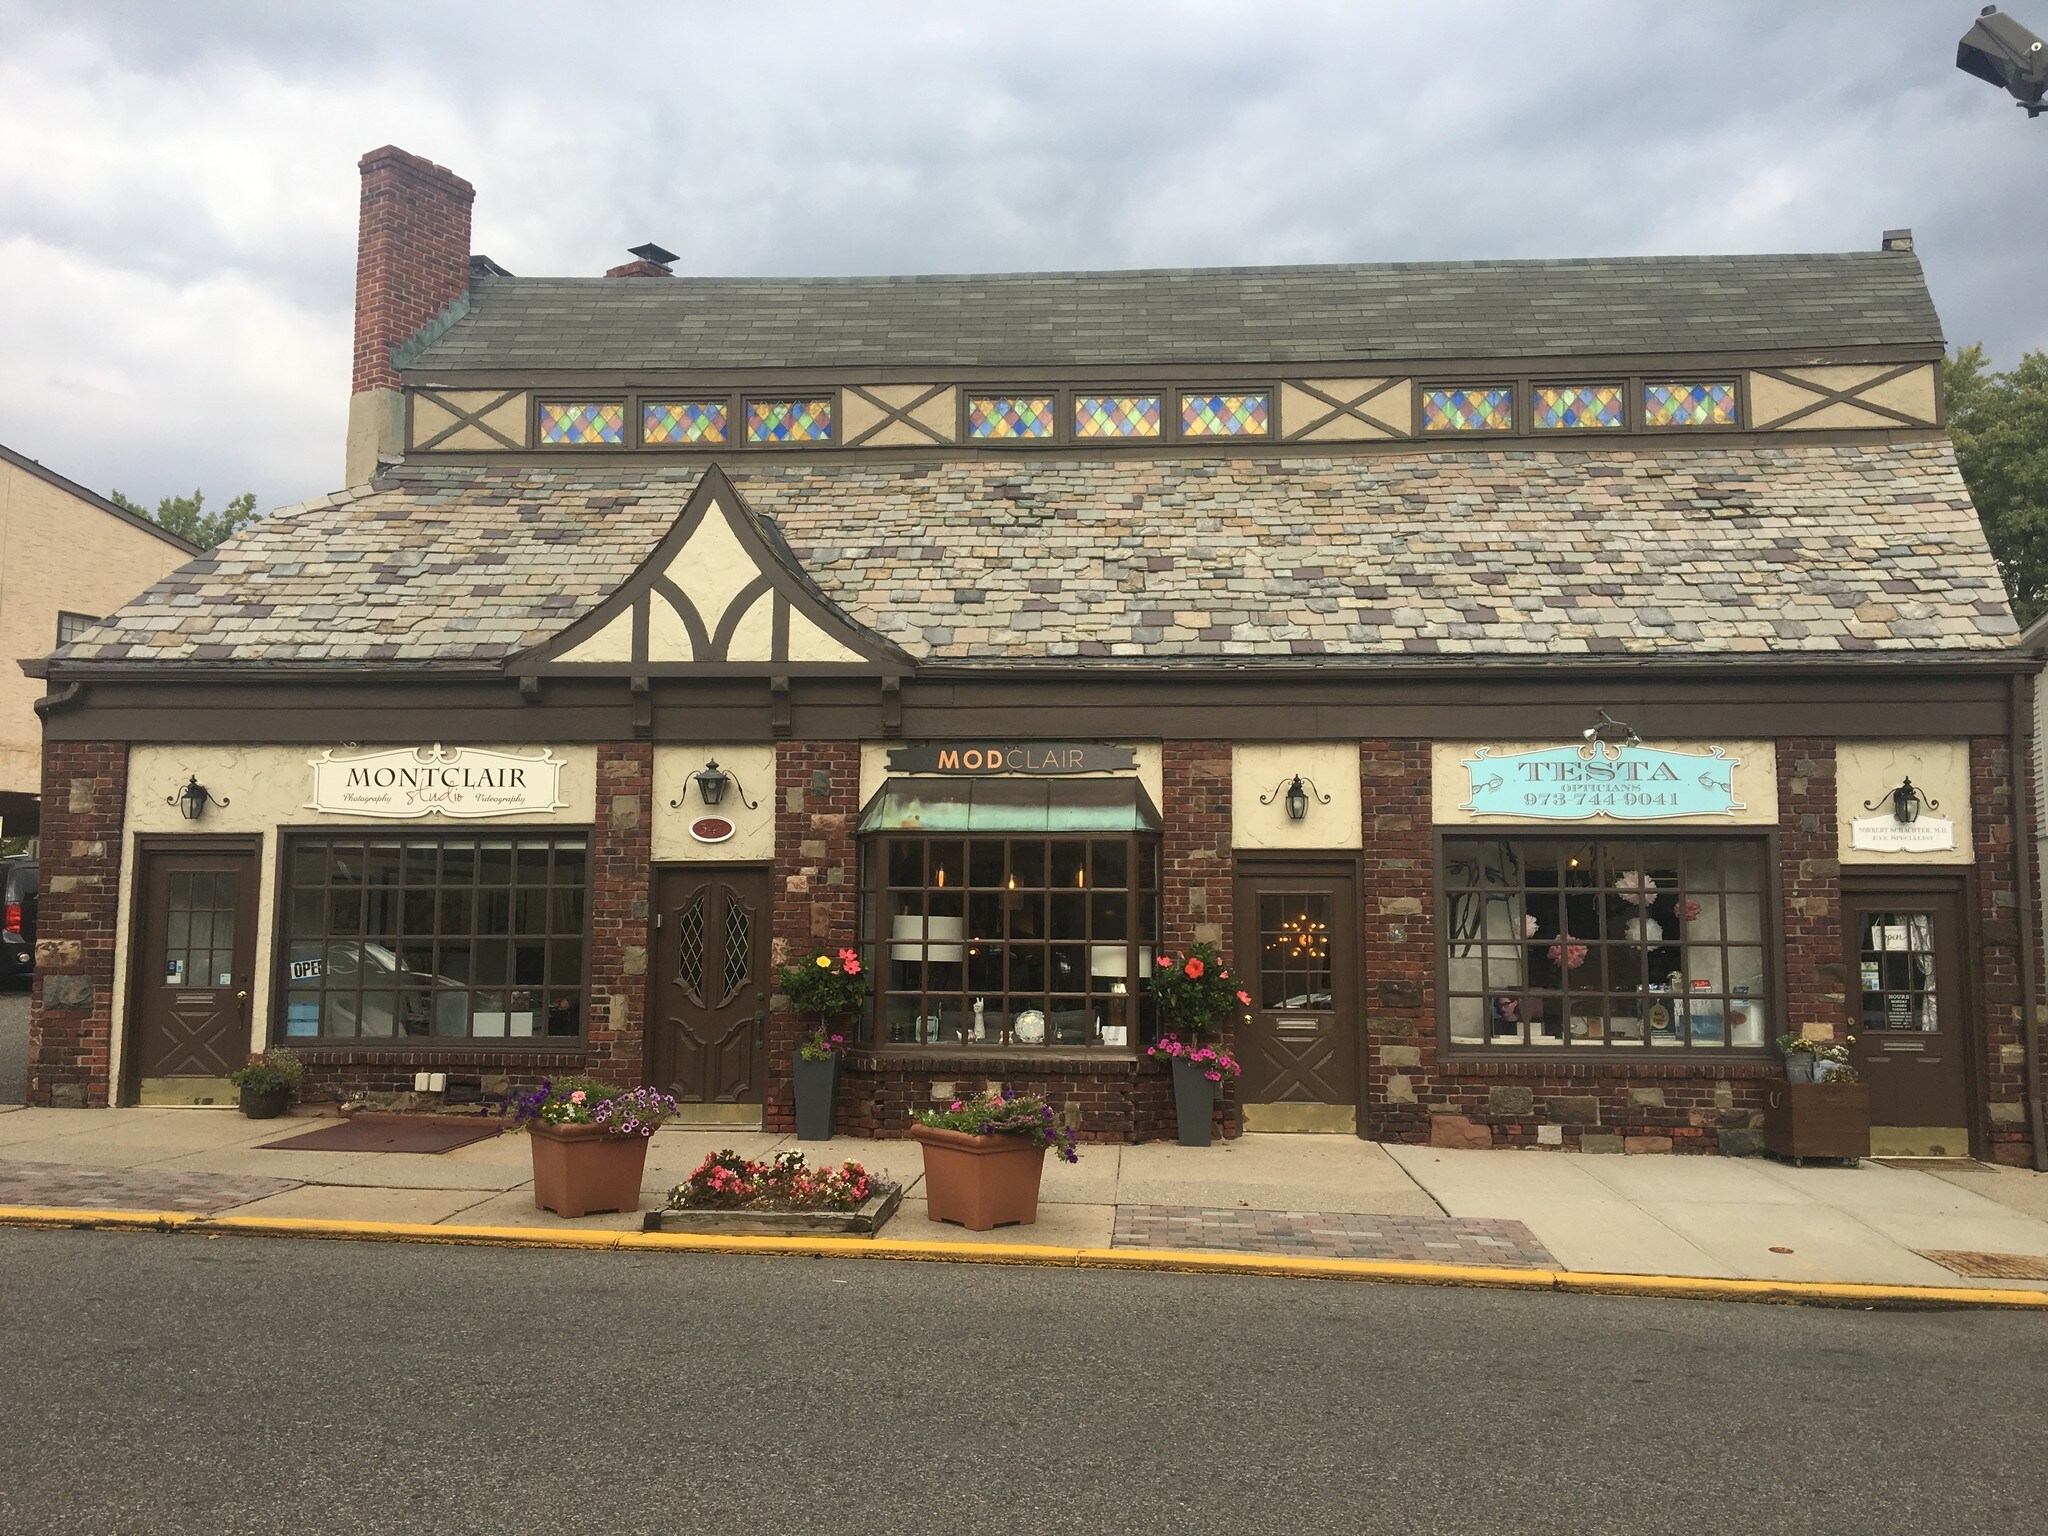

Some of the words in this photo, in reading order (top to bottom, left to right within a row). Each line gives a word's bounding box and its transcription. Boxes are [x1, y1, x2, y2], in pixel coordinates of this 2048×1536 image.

[938, 749, 1084, 770] MODCLAIR
[346, 767, 527, 788] MONTCLAIR
[1518, 761, 1682, 782] TESTA
[405, 777, 464, 806] studio
[1560, 784, 1641, 793] OPTICIANS
[343, 793, 392, 805] Photography
[475, 793, 526, 805] Videography
[1523, 792, 1679, 806] 973-744-9041
